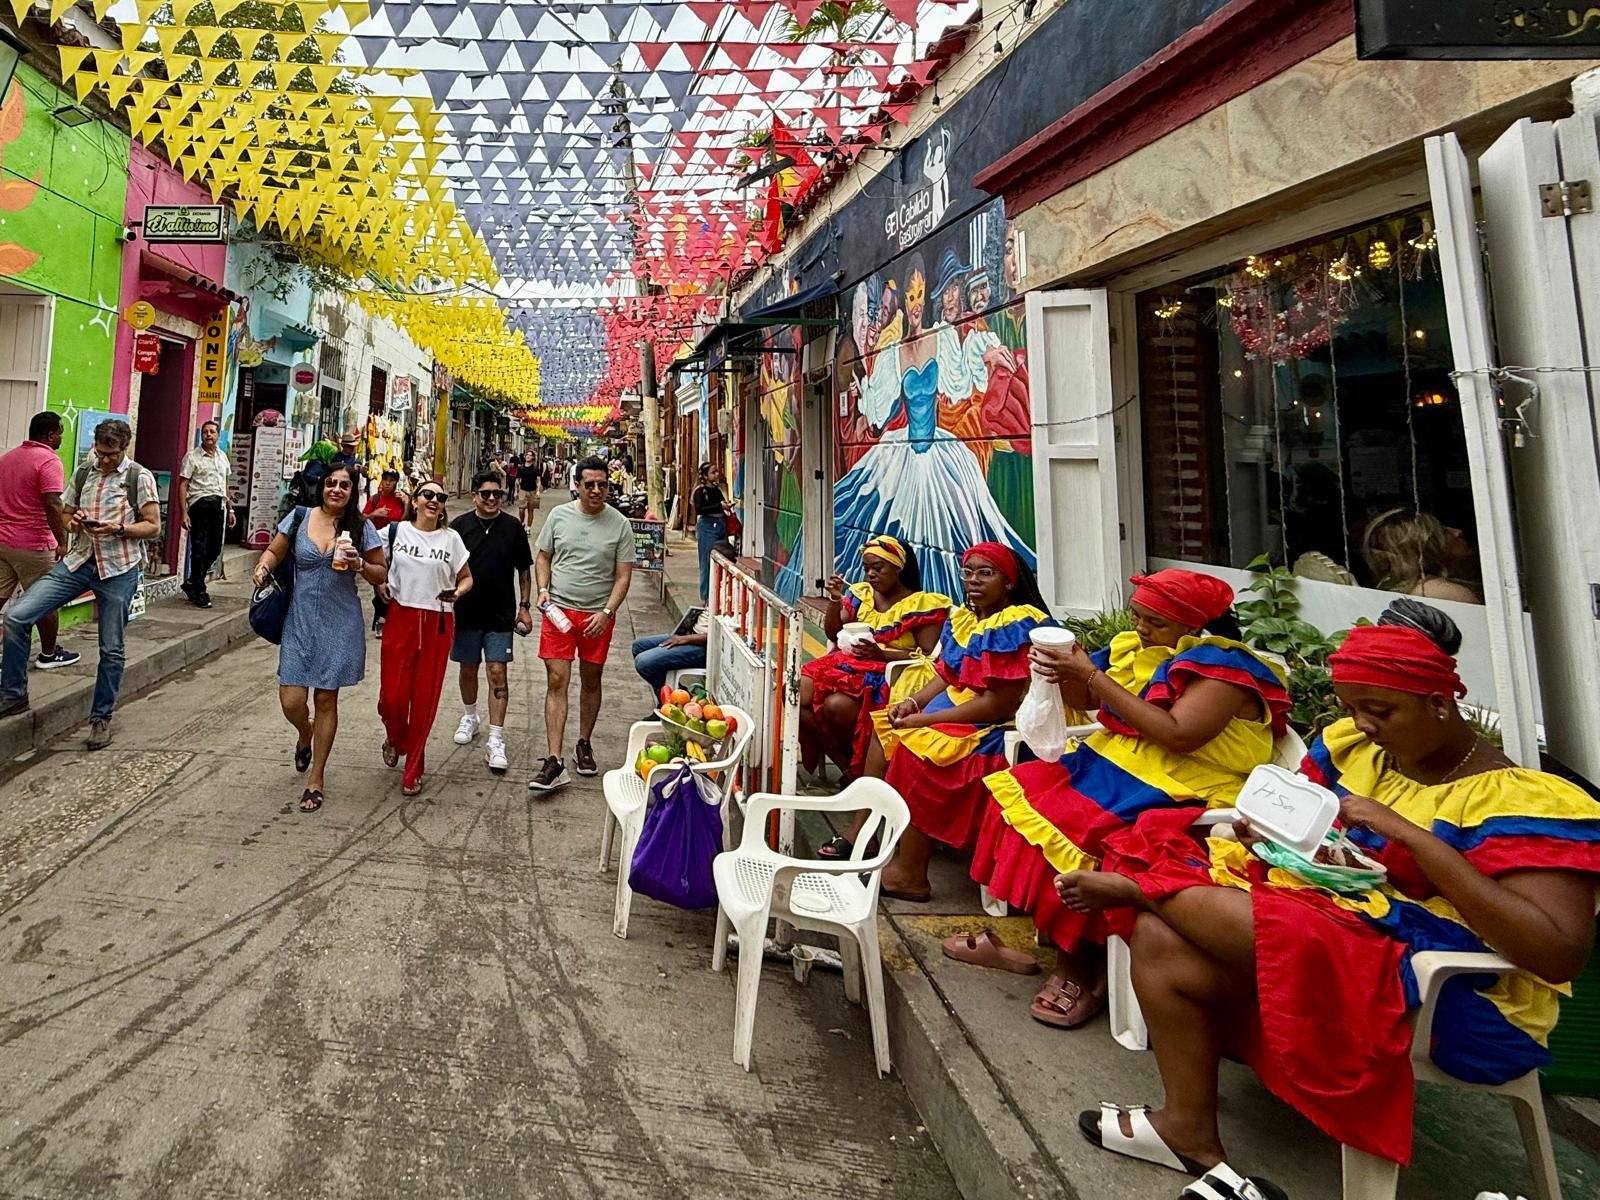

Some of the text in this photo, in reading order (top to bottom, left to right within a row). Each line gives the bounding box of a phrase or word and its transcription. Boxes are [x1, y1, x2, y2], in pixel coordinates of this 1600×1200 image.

[885, 190, 930, 240] El Cabildo
[429, 548, 451, 564] ME
